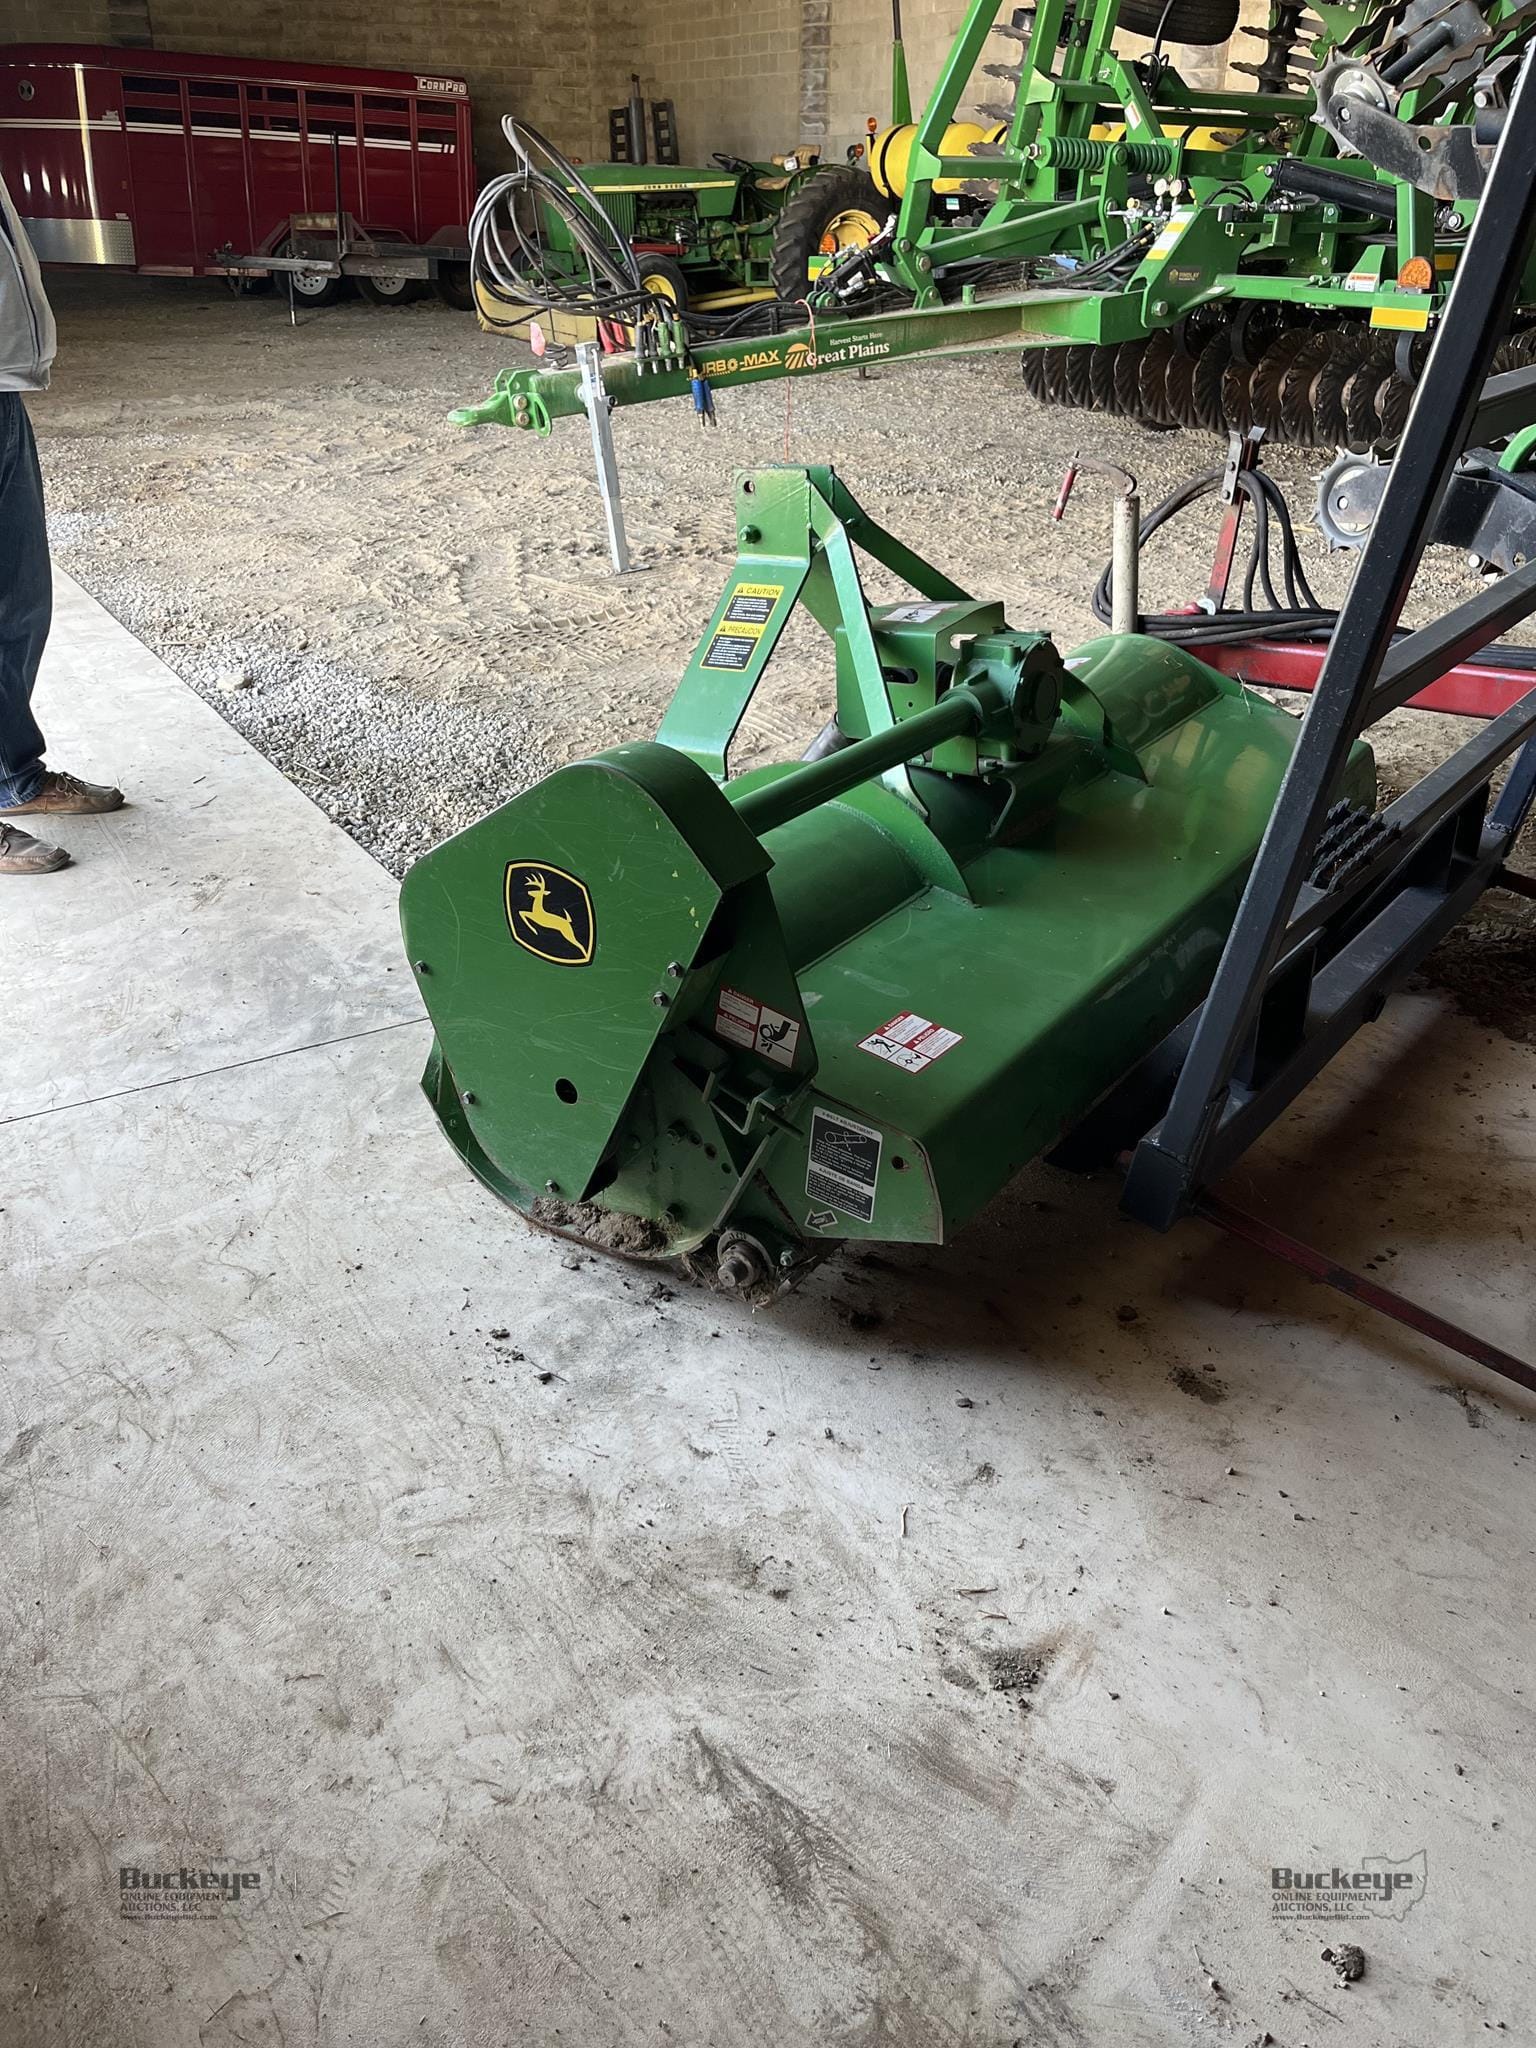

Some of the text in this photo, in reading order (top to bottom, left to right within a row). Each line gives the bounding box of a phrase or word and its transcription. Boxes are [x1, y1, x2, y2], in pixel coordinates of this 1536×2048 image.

[829, 337, 852, 346] Harvest
[852, 334, 869, 342] Starts
[806, 342, 890, 366] Great Plains
[746, 587, 780, 596] CAUTION
